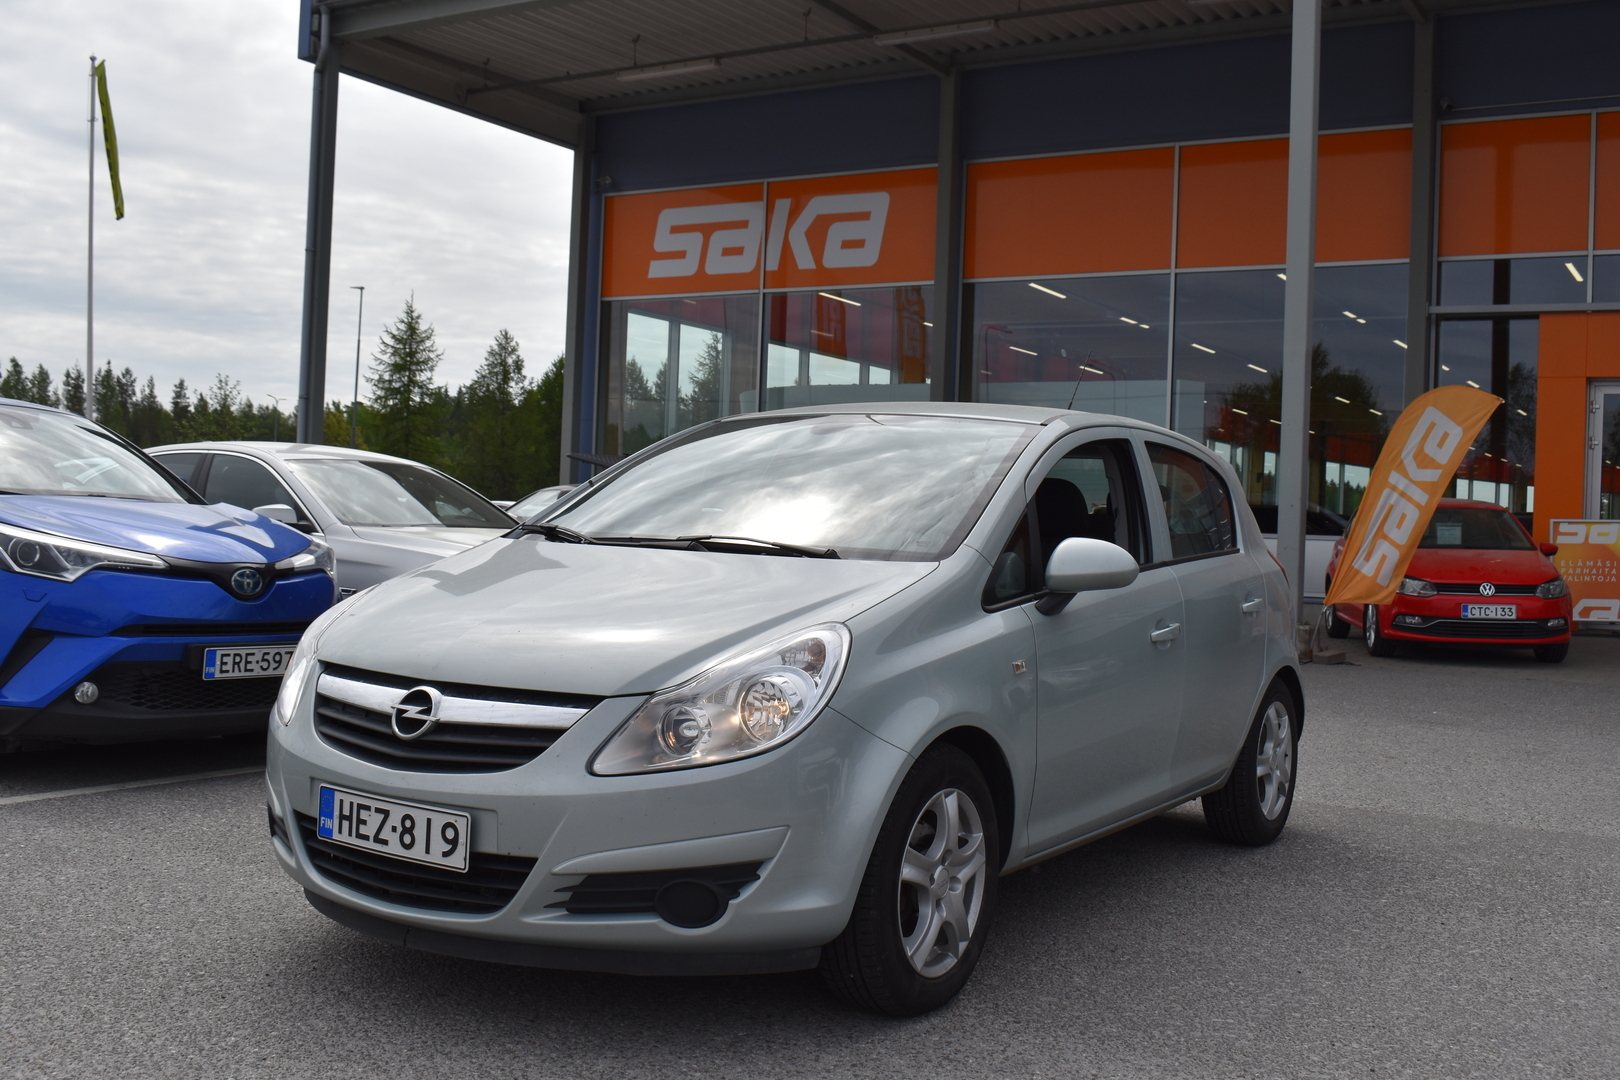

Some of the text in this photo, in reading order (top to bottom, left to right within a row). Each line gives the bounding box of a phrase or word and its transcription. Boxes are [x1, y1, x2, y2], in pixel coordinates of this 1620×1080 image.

[1470, 606, 1514, 617] CTC-133
[320, 798, 459, 858] FIN HEZ-819
